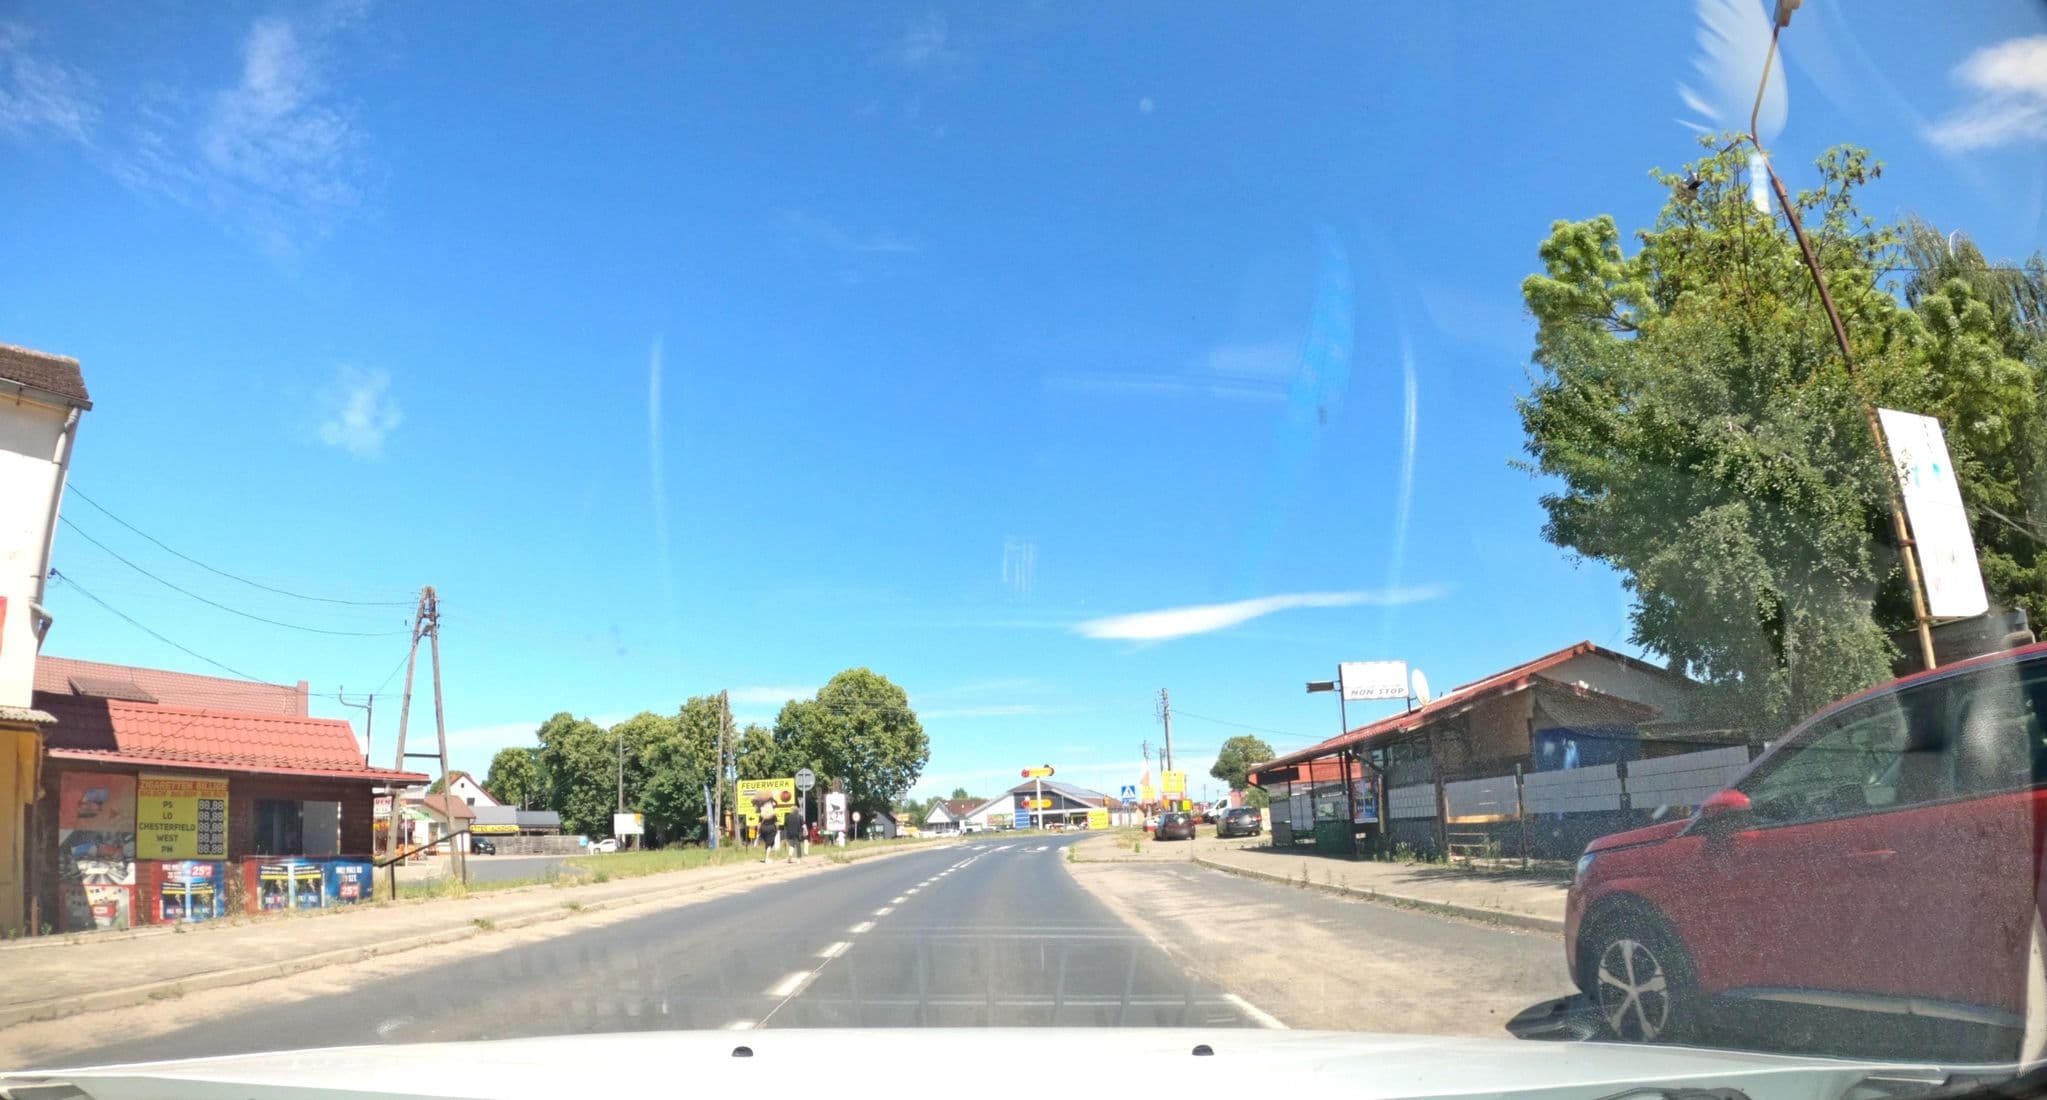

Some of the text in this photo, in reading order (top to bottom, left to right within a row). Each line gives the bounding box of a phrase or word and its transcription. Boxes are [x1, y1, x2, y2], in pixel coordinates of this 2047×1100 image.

[1351, 687, 1405, 696] NON STOP
[741, 780, 790, 789] FEUERWERK
[139, 823, 196, 832] CHESTERFIELD
[156, 834, 179, 842] WEST
